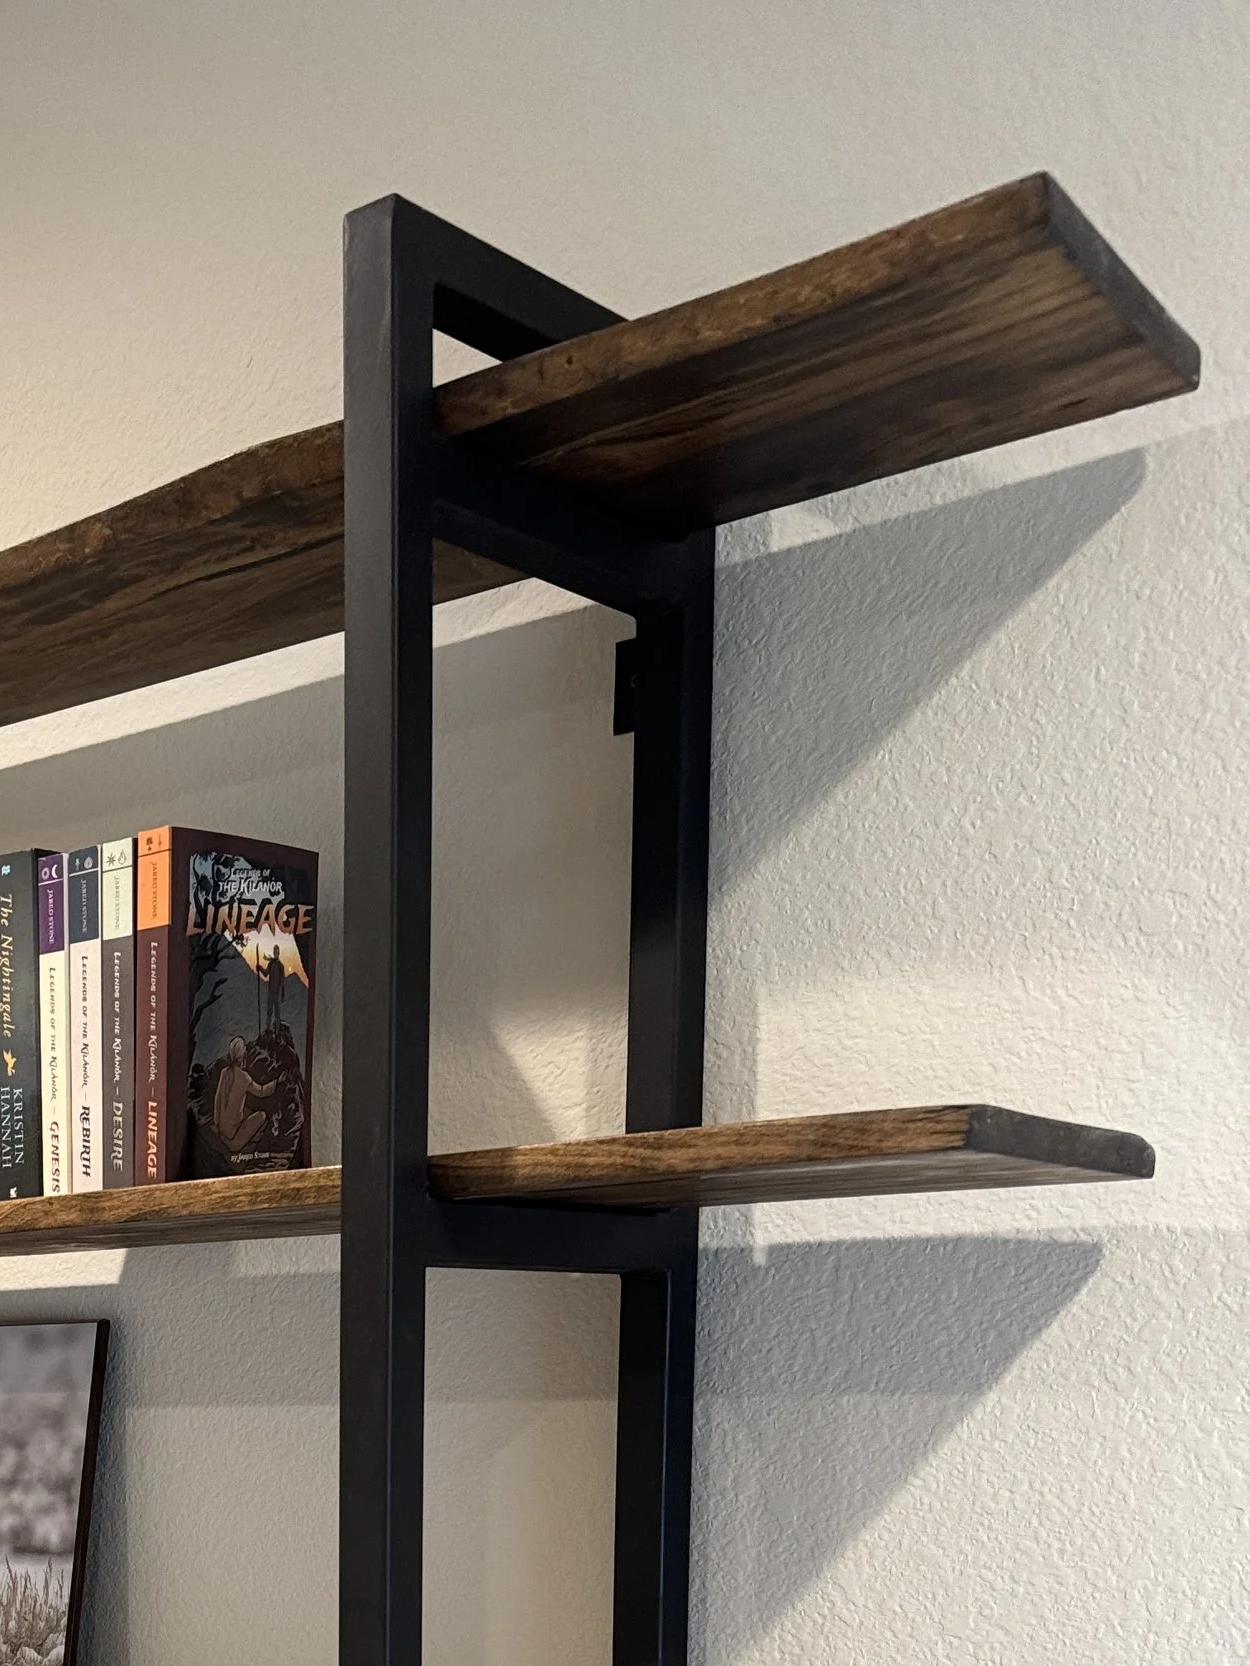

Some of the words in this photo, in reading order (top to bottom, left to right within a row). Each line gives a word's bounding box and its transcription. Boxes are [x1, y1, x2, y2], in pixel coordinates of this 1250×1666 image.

[0, 894, 13, 927] The
[218, 882, 237, 893] THE
[186, 903, 315, 937] LINEAGE
[113, 952, 121, 998] LEGENDS
[150, 942, 158, 991] LEGENDS
[82, 1005, 88, 1018] OF
[114, 1001, 120, 1013] OF
[150, 994, 156, 1007] OF
[50, 1018, 56, 1030] OF
[0, 1087, 12, 1168] HANNAH
[13, 1088, 25, 1164] KRISTIN
[79, 1105, 91, 1178] REBIRTH
[111, 1101, 123, 1172] DESIRE
[147, 1101, 158, 1179] LINEAGE
[49, 1121, 60, 1193] GENESIS
